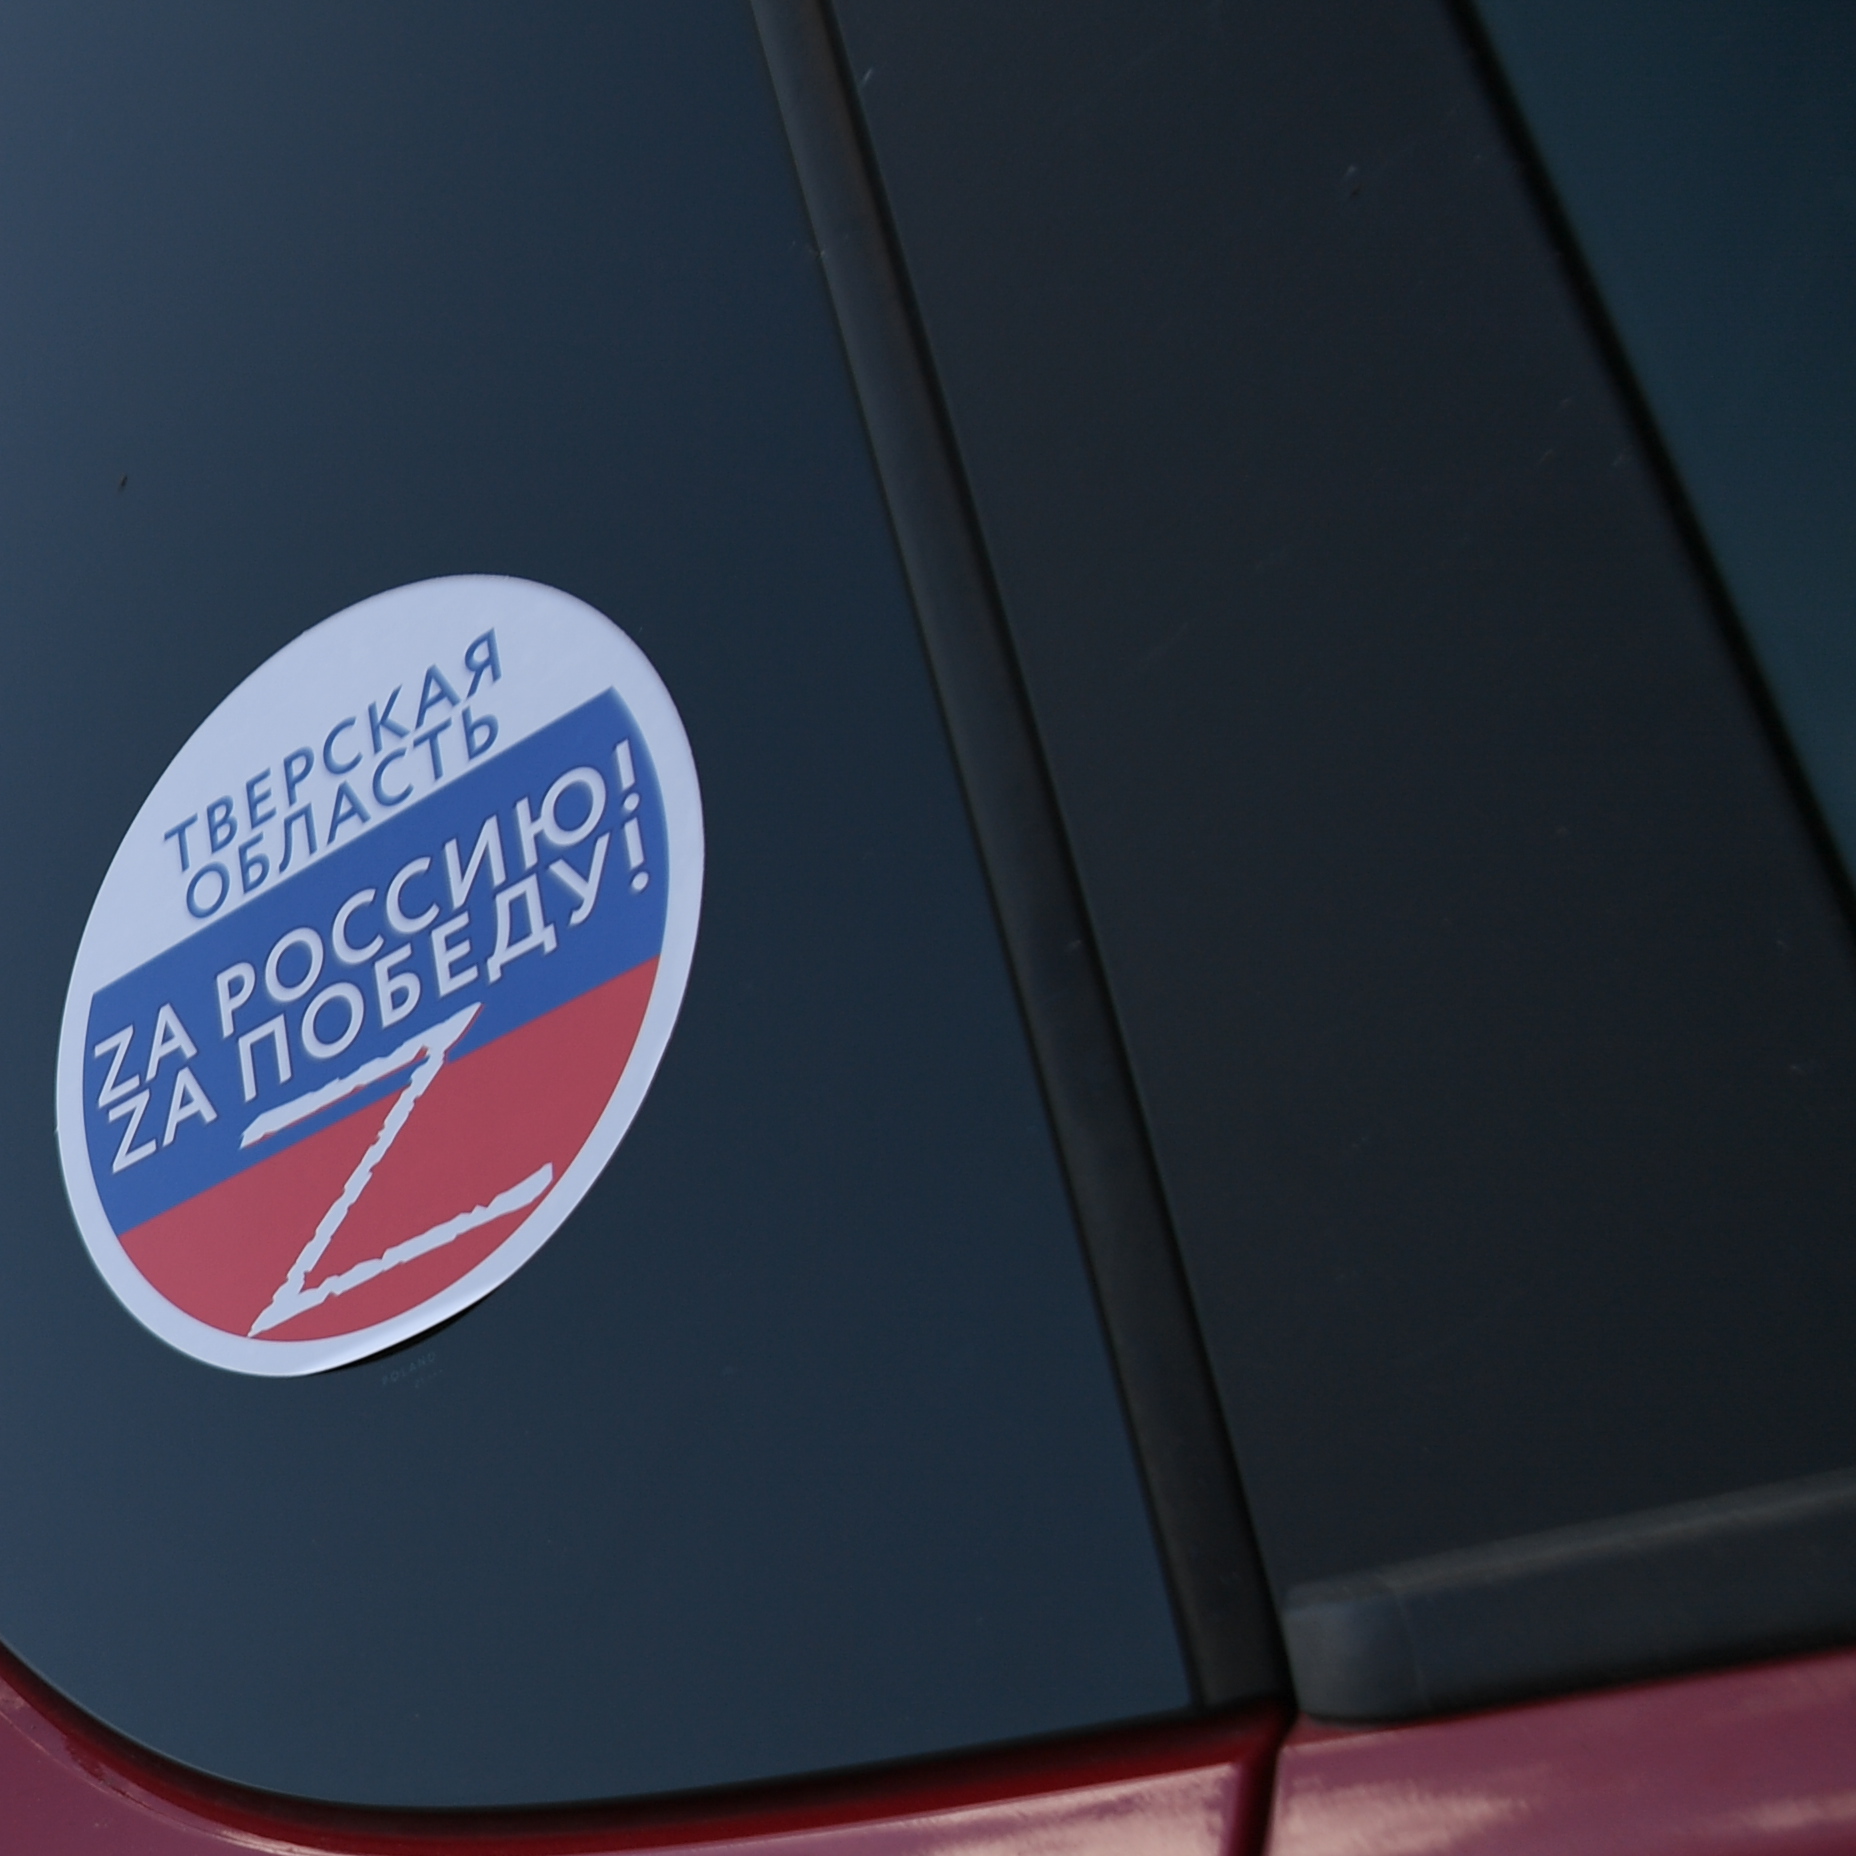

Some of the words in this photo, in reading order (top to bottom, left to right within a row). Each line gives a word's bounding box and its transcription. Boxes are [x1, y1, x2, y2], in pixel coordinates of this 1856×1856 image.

[164, 627, 502, 873] ТВЕРСКАЯ
[186, 708, 500, 919] ОБЛАСТЬ
[94, 1003, 197, 1109] ZA
[216, 738, 642, 1039] РОССИЮ!
[109, 1080, 217, 1174] ZA
[237, 830, 651, 1103] ПОБЕДУ!
[239, 1002, 553, 1338] Z
